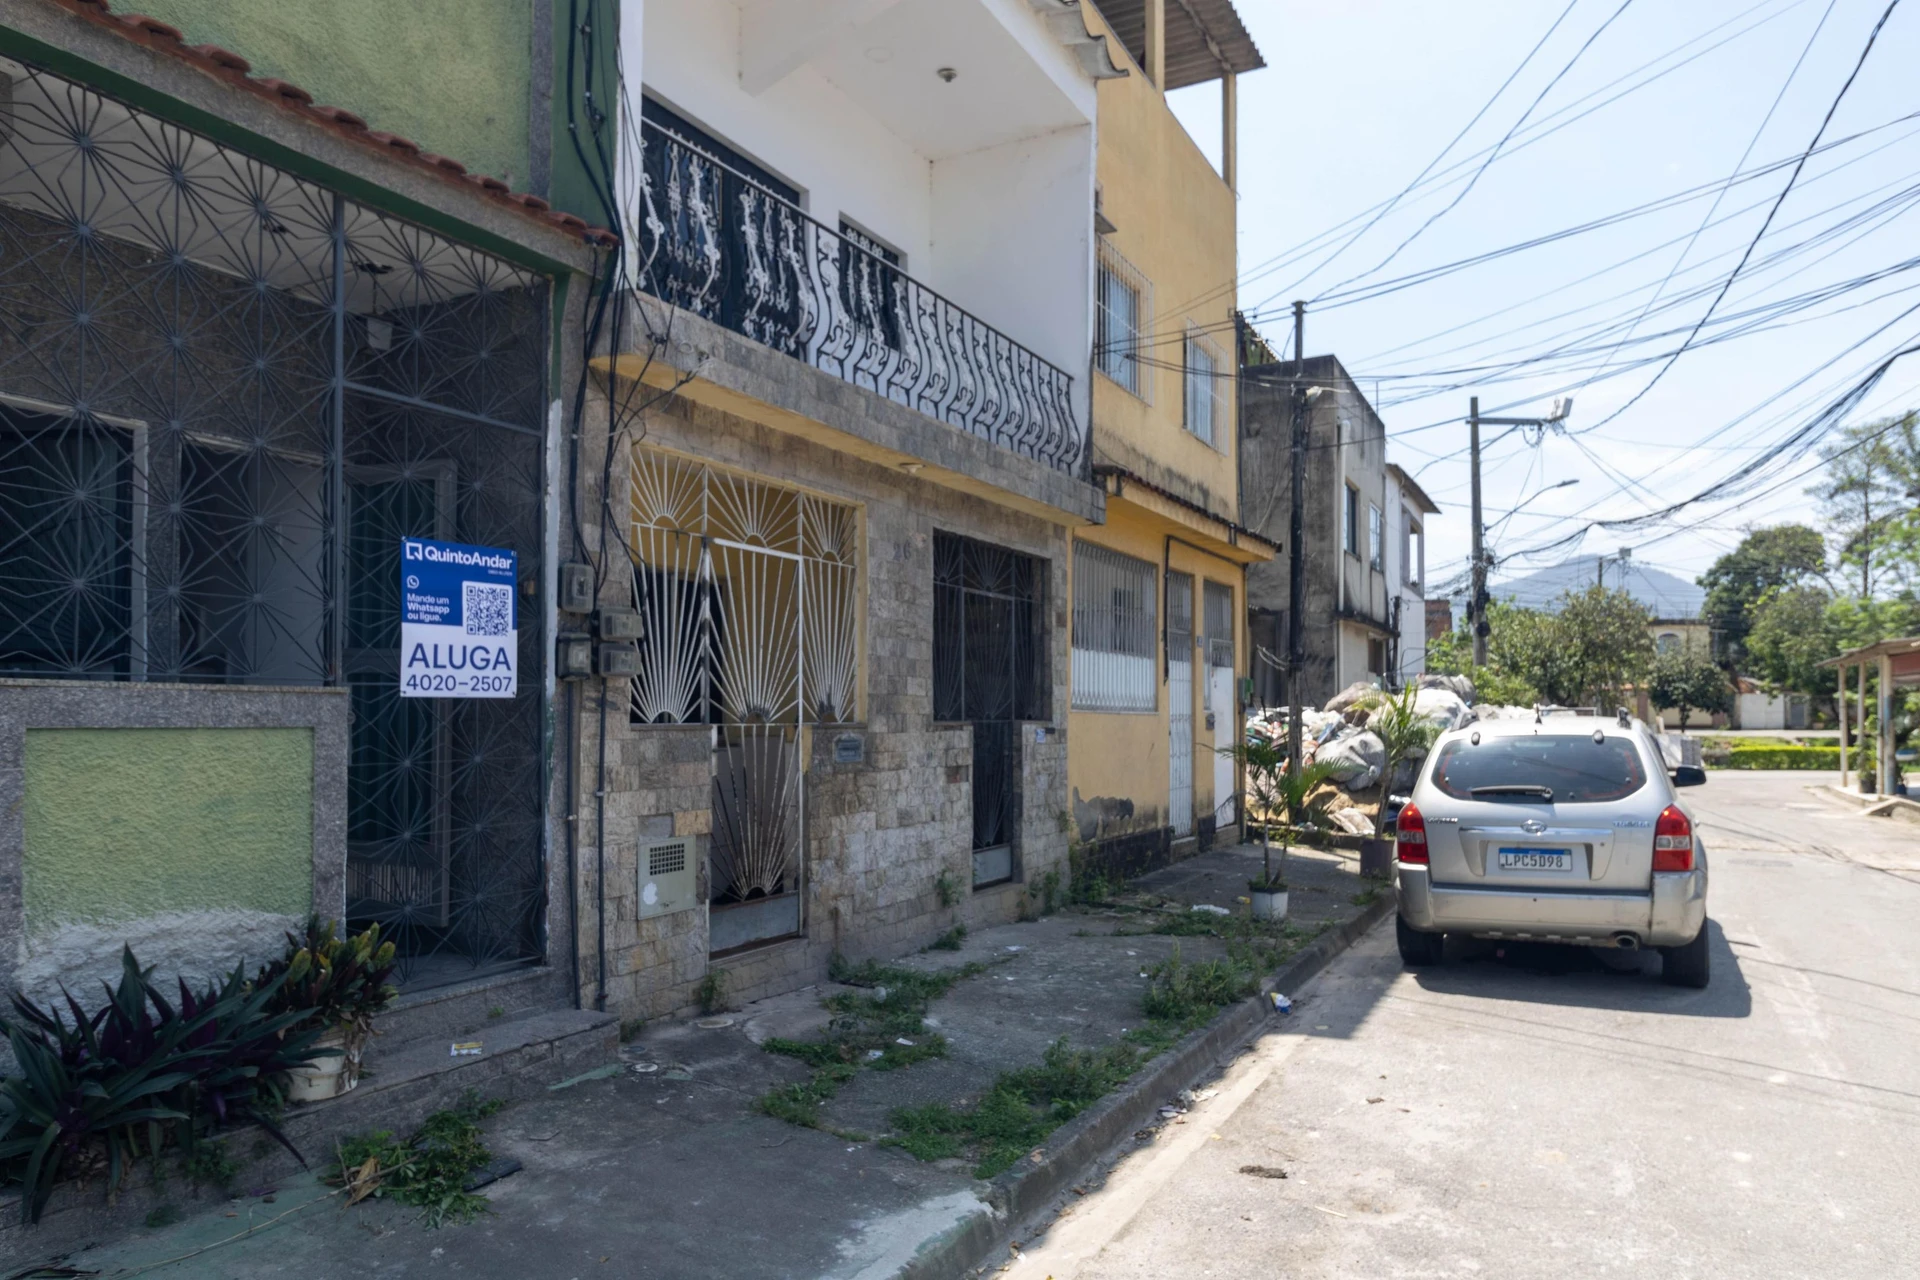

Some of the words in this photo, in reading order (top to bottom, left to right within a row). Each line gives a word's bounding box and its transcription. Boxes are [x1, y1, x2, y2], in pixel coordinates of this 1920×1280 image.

[424, 546, 512, 569] QuintoAndar
[407, 593, 435, 604] Mande
[436, 597, 449, 605] um
[407, 602, 450, 615] Whatsapp
[407, 612, 419, 620] ou
[420, 612, 442, 622] ligue.
[407, 643, 512, 671] ALUGA
[406, 674, 512, 692] 4020-2507
[1505, 854, 1563, 868] LPC5D98
